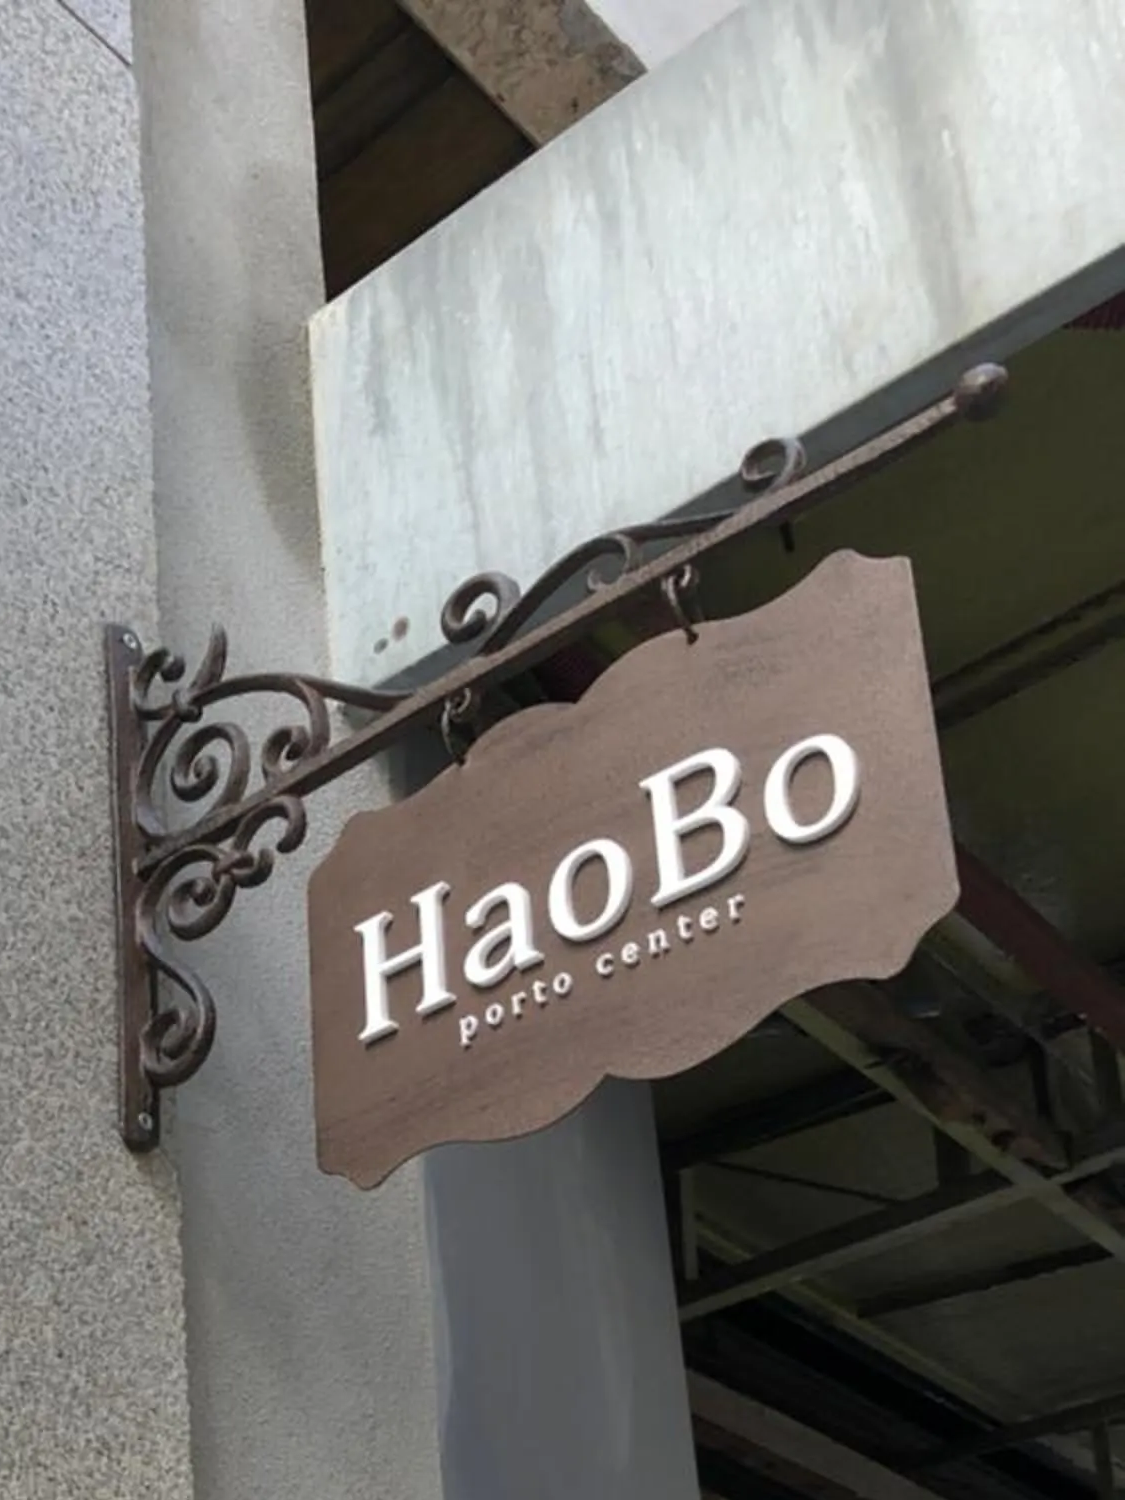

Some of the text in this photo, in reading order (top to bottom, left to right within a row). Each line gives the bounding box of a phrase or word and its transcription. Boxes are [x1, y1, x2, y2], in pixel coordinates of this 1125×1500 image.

[354, 733, 860, 1043] HaoBo
[459, 893, 746, 1046] porto center
